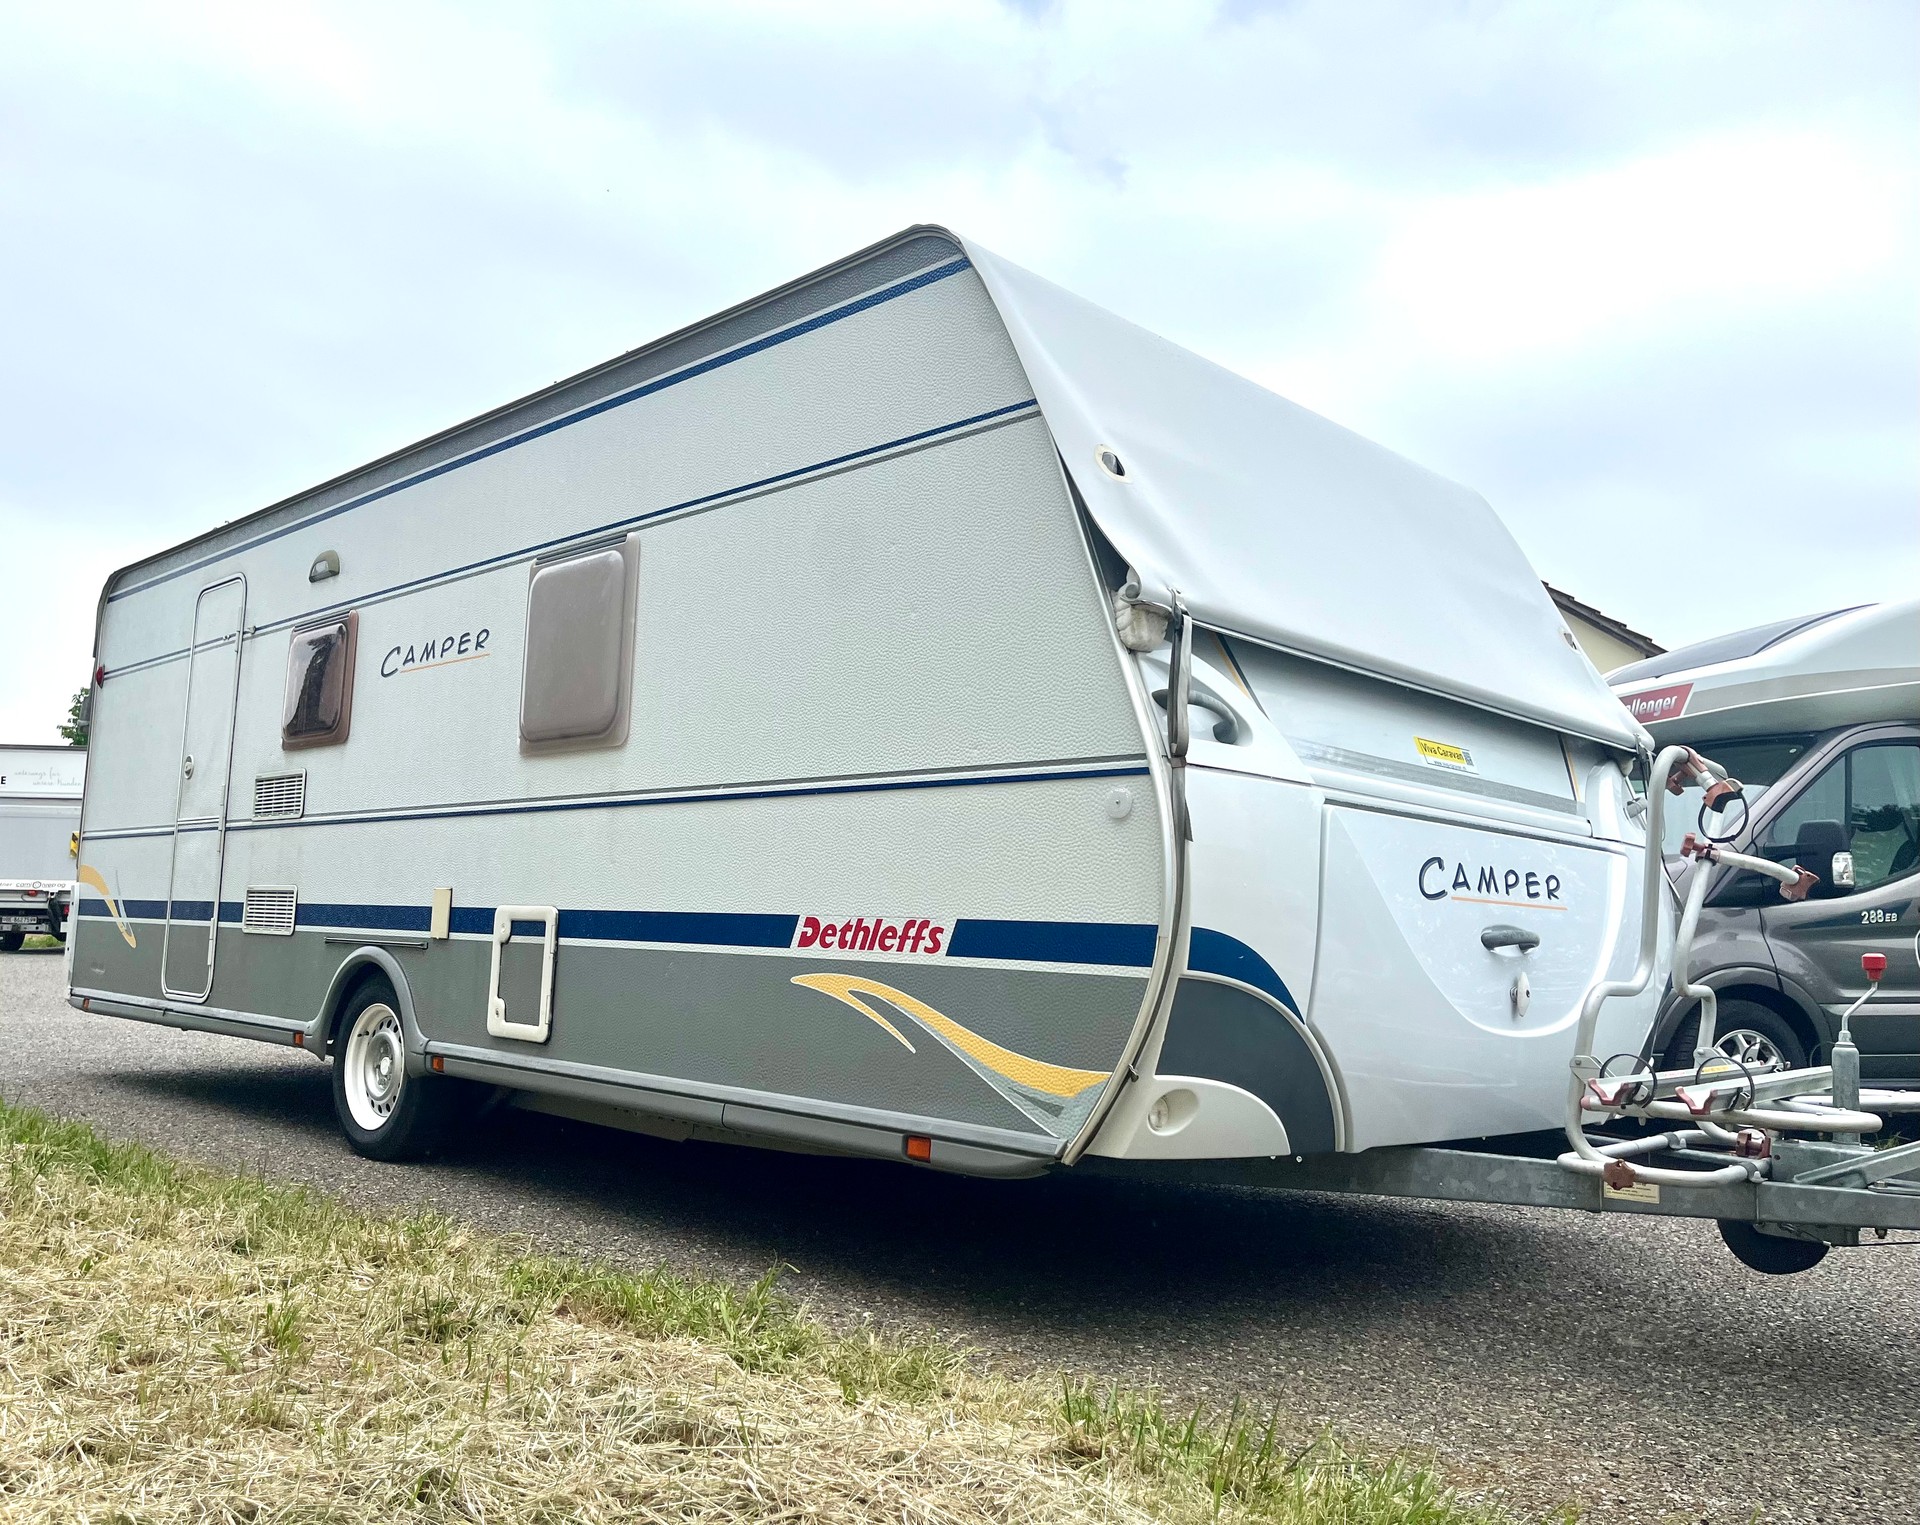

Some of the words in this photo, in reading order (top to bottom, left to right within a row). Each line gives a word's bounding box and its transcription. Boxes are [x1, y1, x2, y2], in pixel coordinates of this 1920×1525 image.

[380, 628, 490, 678] CAMPER
[1420, 742, 1438, 755] Viva
[1437, 746, 1464, 761] Caravan
[1418, 856, 1561, 901] CAMPER
[797, 916, 945, 954] Dethleffs
[1861, 909, 1884, 924] 288
[1884, 912, 1898, 922] EB
